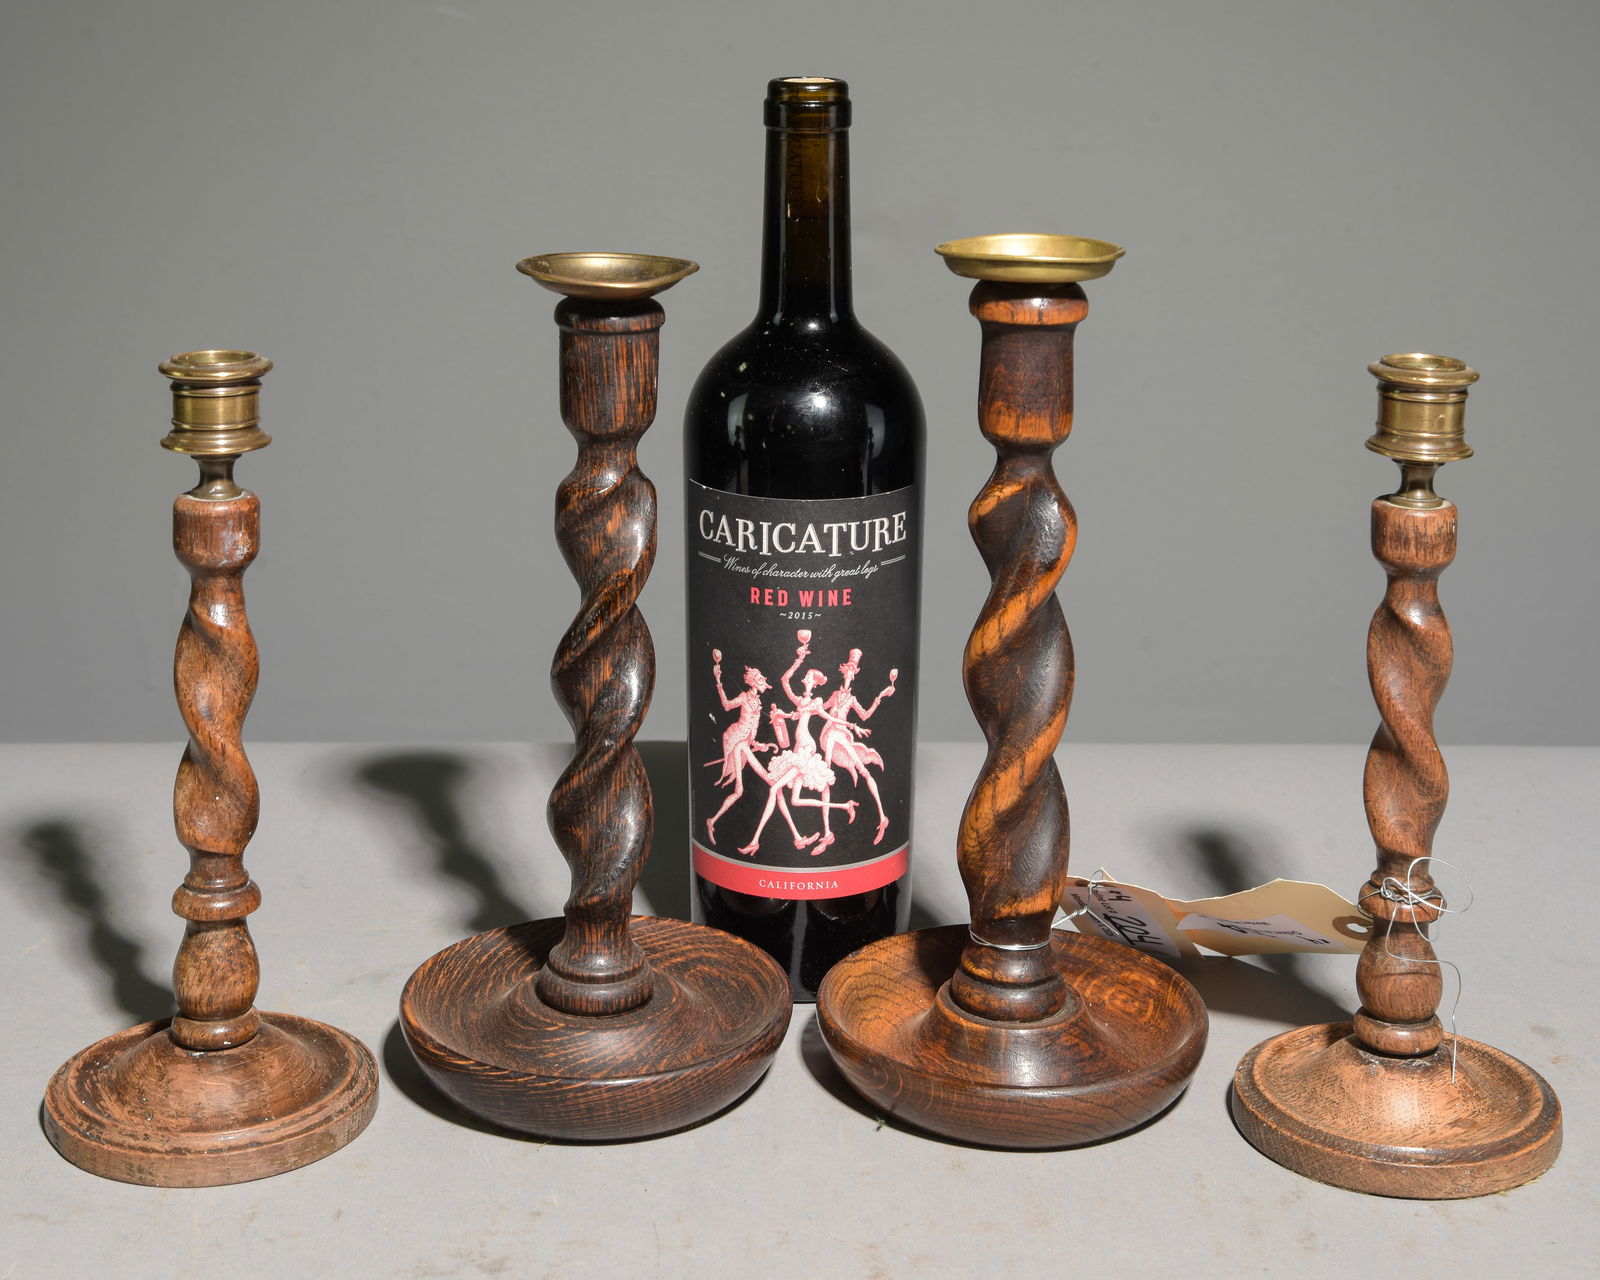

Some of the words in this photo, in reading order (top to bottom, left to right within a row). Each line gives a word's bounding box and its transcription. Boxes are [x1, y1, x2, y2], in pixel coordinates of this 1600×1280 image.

[699, 509, 907, 557] CARICATURE
[723, 554, 751, 574] Wines
[751, 562, 767, 580] of
[762, 563, 809, 579] character
[809, 563, 837, 578] with
[830, 565, 861, 583] great
[860, 559, 879, 580] legs
[750, 586, 789, 607] RED
[798, 588, 853, 608] WINE
[758, 879, 839, 891] CALIFORNIA
